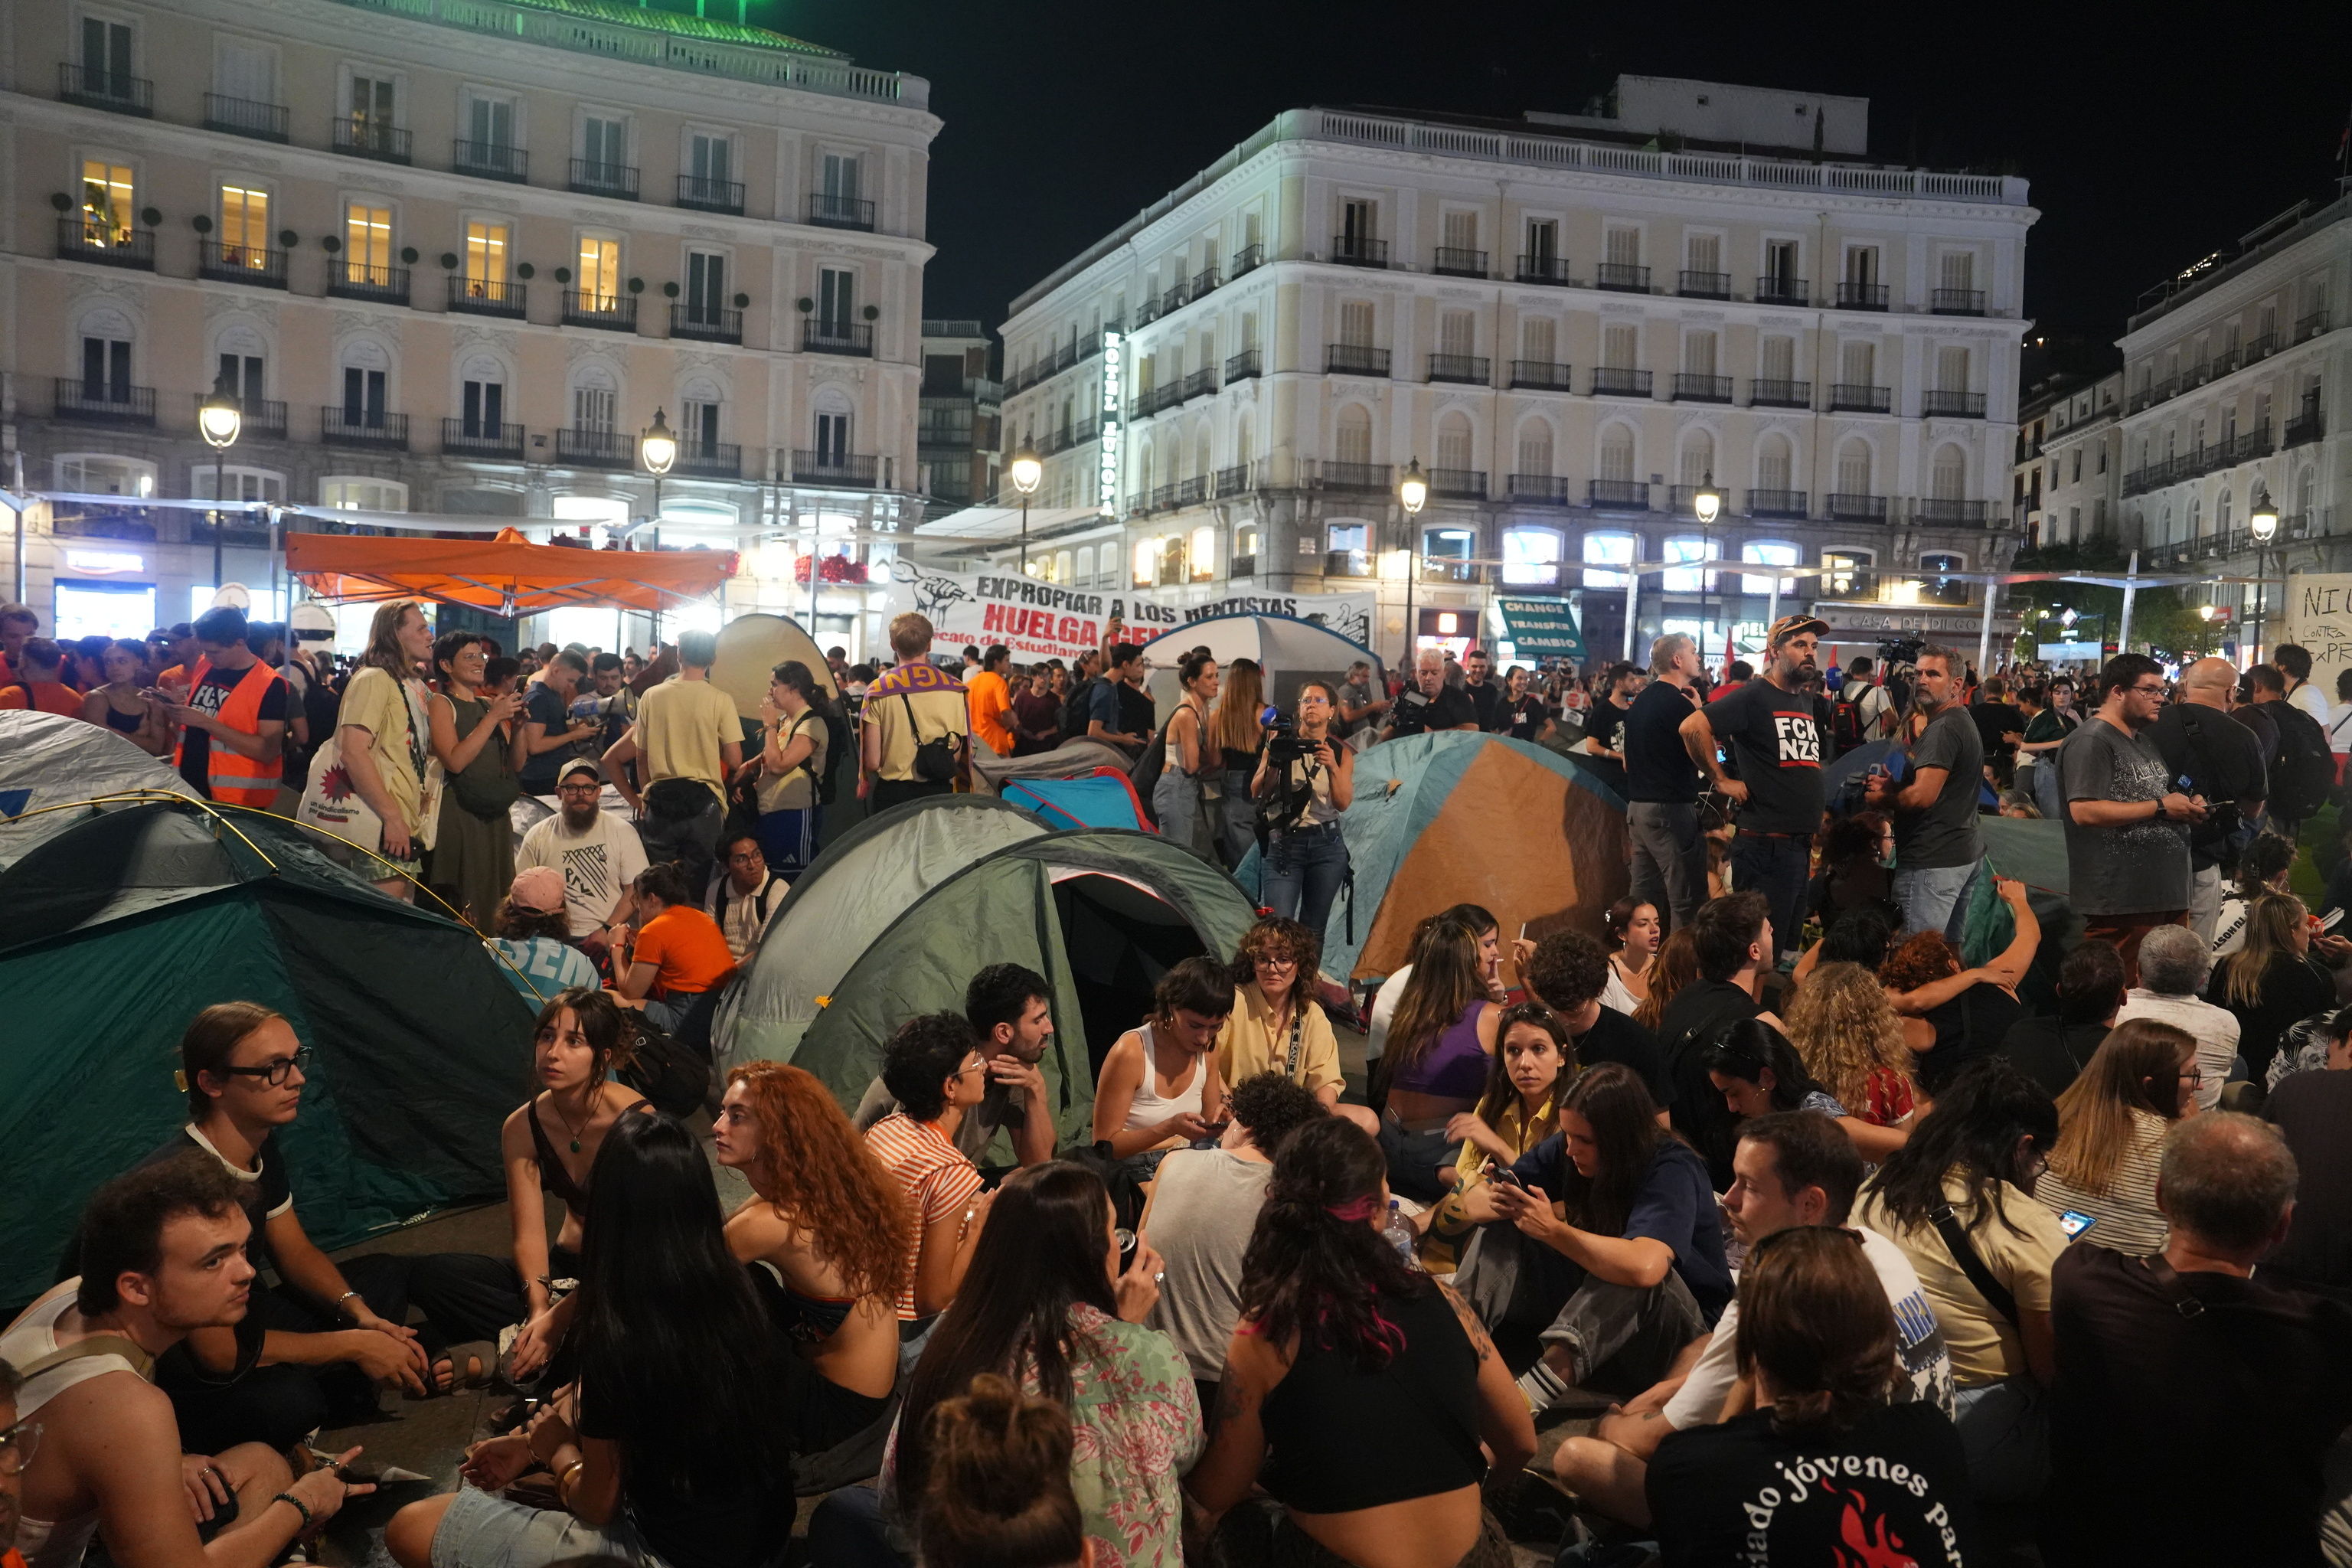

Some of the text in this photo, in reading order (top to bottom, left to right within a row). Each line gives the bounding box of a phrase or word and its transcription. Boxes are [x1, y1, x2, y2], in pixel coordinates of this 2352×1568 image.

[1099, 332, 1120, 516] HOTEL EUROPA
[976, 576, 1297, 623] EXPROPIAR A LOS RENTISTAS
[1504, 602, 1565, 614] CHANGE
[982, 603, 1099, 647] HUELGA
[1511, 620, 1571, 631] TRANSFER
[1850, 616, 1890, 629] CASA
[1902, 617, 1922, 629] DE
[932, 627, 976, 645] icato
[979, 635, 1001, 646] de
[1517, 636, 1577, 648] CAMBIO
[1775, 717, 1820, 743] FCK
[1779, 738, 1820, 763] NZS
[1735, 1487, 1782, 1568] iado
[1775, 1455, 1929, 1503] jóvenes
